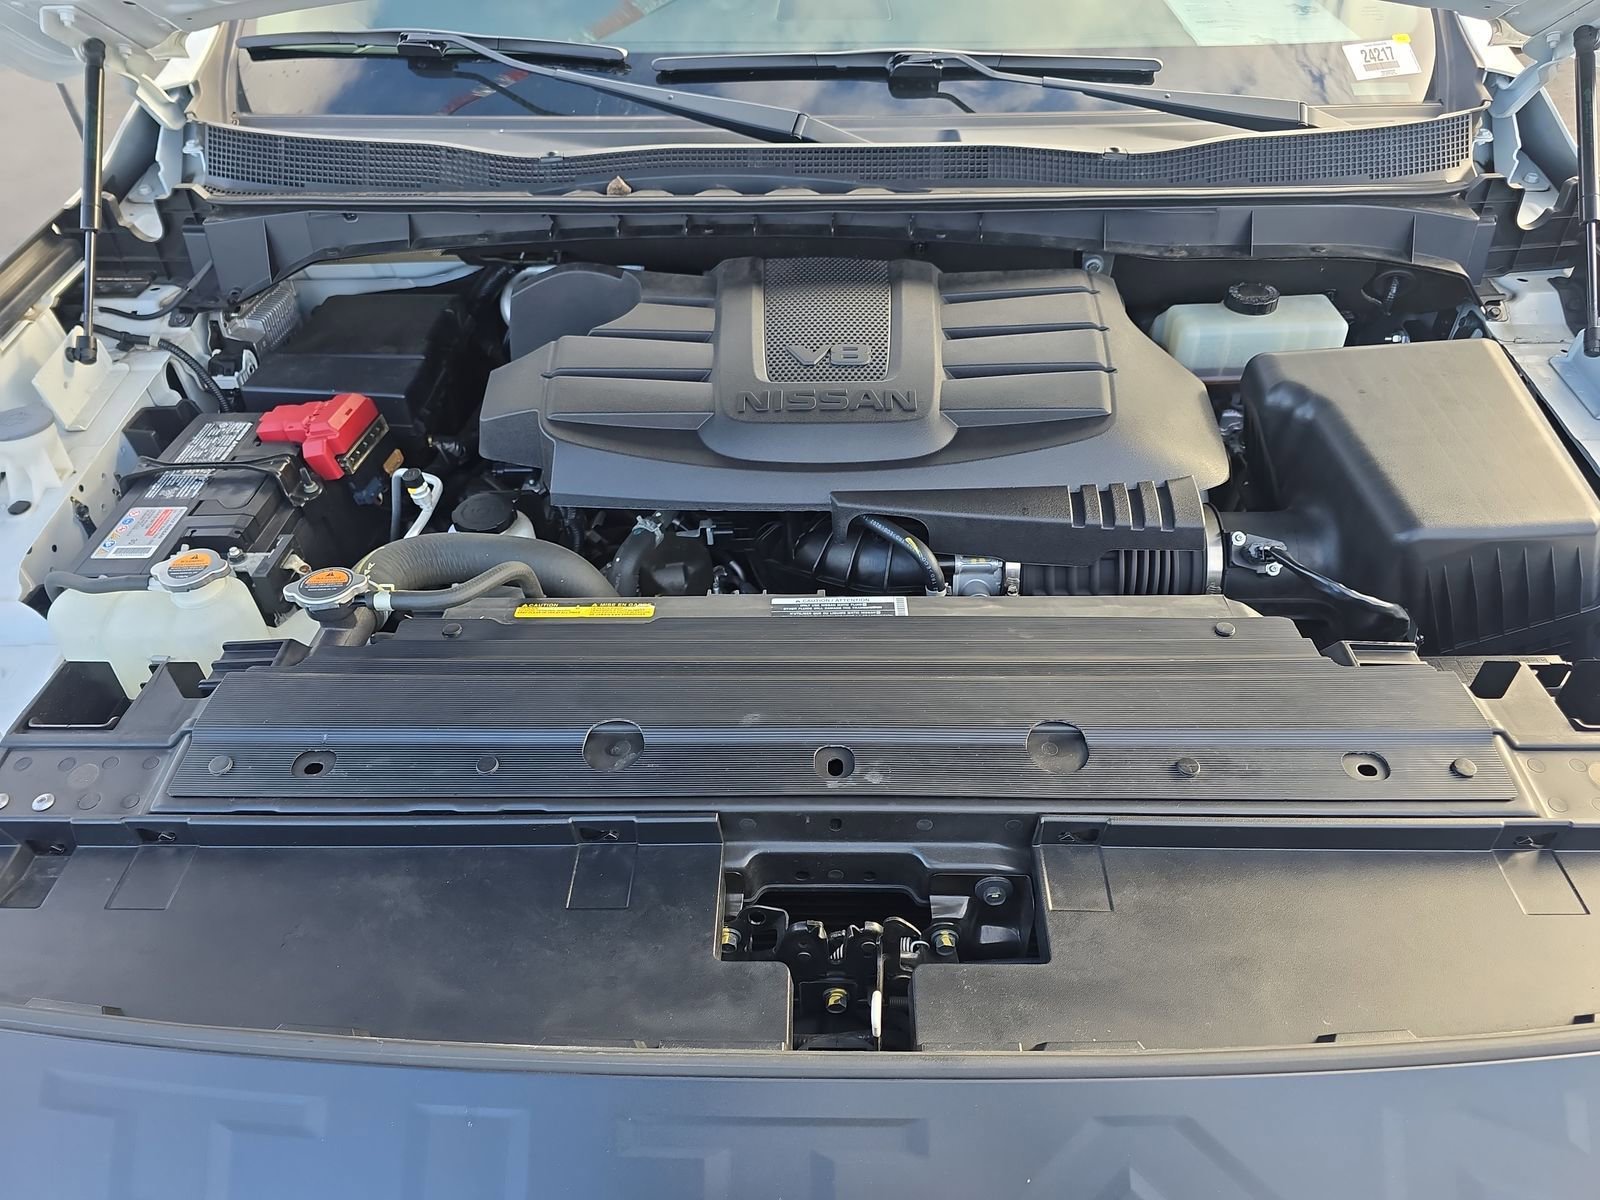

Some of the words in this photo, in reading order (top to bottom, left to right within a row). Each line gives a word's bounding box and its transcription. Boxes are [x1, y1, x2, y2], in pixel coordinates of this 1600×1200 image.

[1360, 46, 1394, 63] 24217
[785, 343, 872, 366] V8
[732, 388, 917, 414] NISSAN
